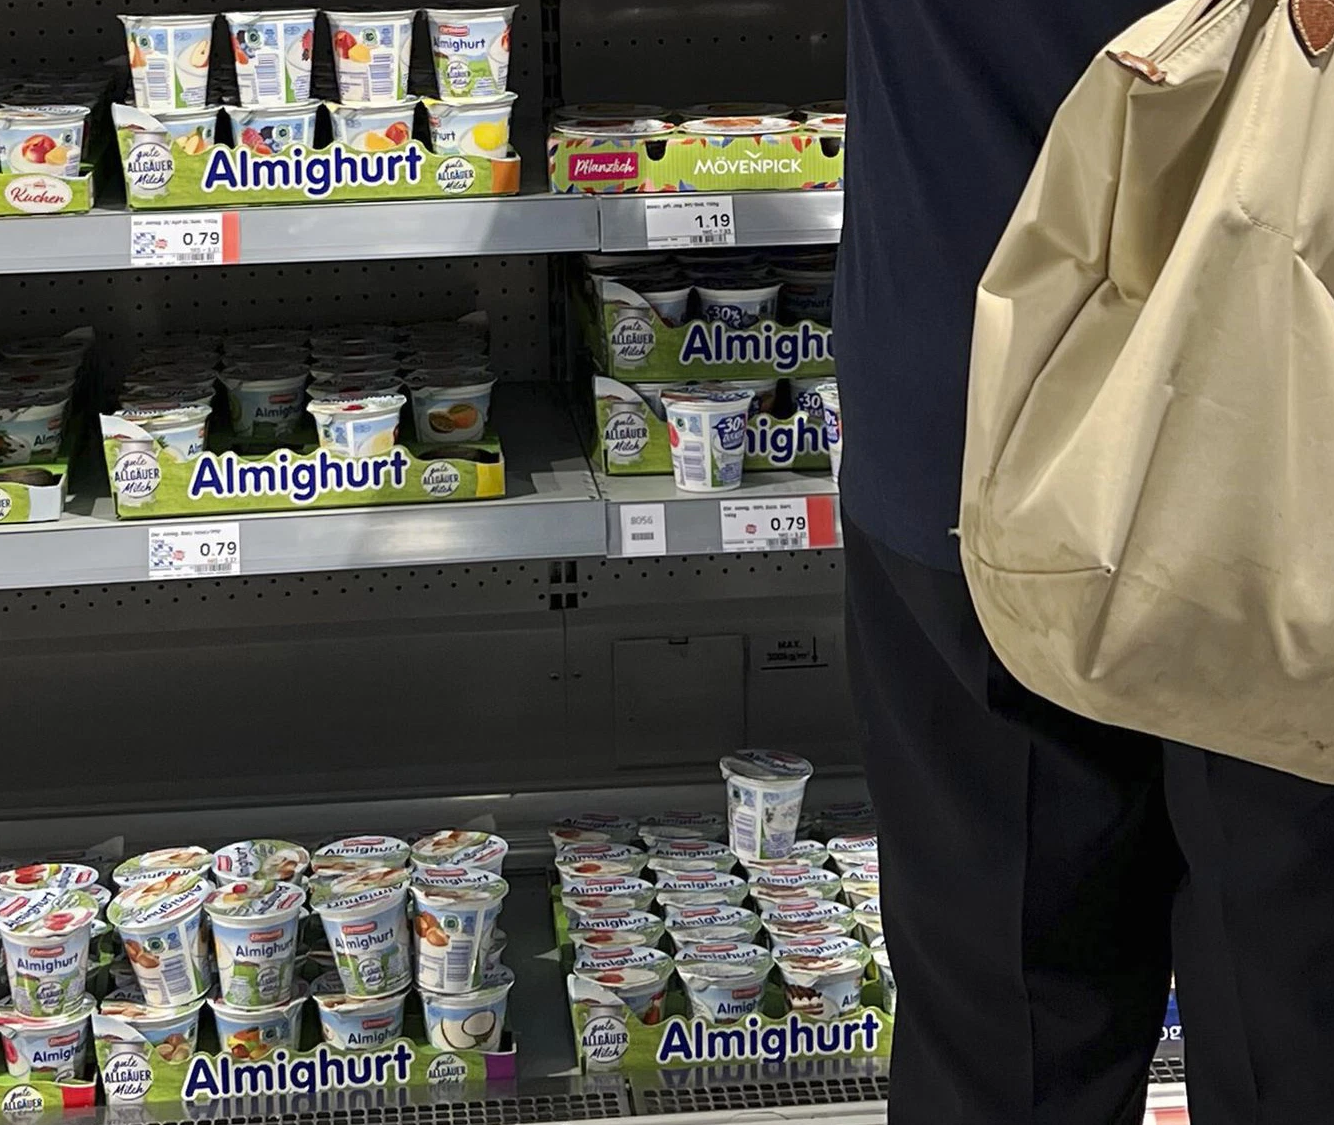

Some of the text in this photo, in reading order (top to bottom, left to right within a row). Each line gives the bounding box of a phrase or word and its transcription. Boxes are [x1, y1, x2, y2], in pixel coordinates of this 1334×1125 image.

[127, 159, 174, 174] ALLGÄUER
[203, 145, 422, 195] Almighurt
[693, 155, 803, 176] MÖVENPICK
[135, 173, 166, 189] Milch
[10, 186, 66, 207] Kuchen
[694, 213, 731, 229] 1.19
[182, 231, 221, 246] 0.79
[681, 324, 835, 371] Almigh
[114, 468, 160, 482] ALLGÄUER
[191, 451, 408, 500] Almighurt
[769, 516, 807, 532] 0.79
[659, 1012, 881, 1063] Almighurt
[104, 1069, 153, 1084] ALLGÄUER
[112, 1082, 144, 1099] Milch
